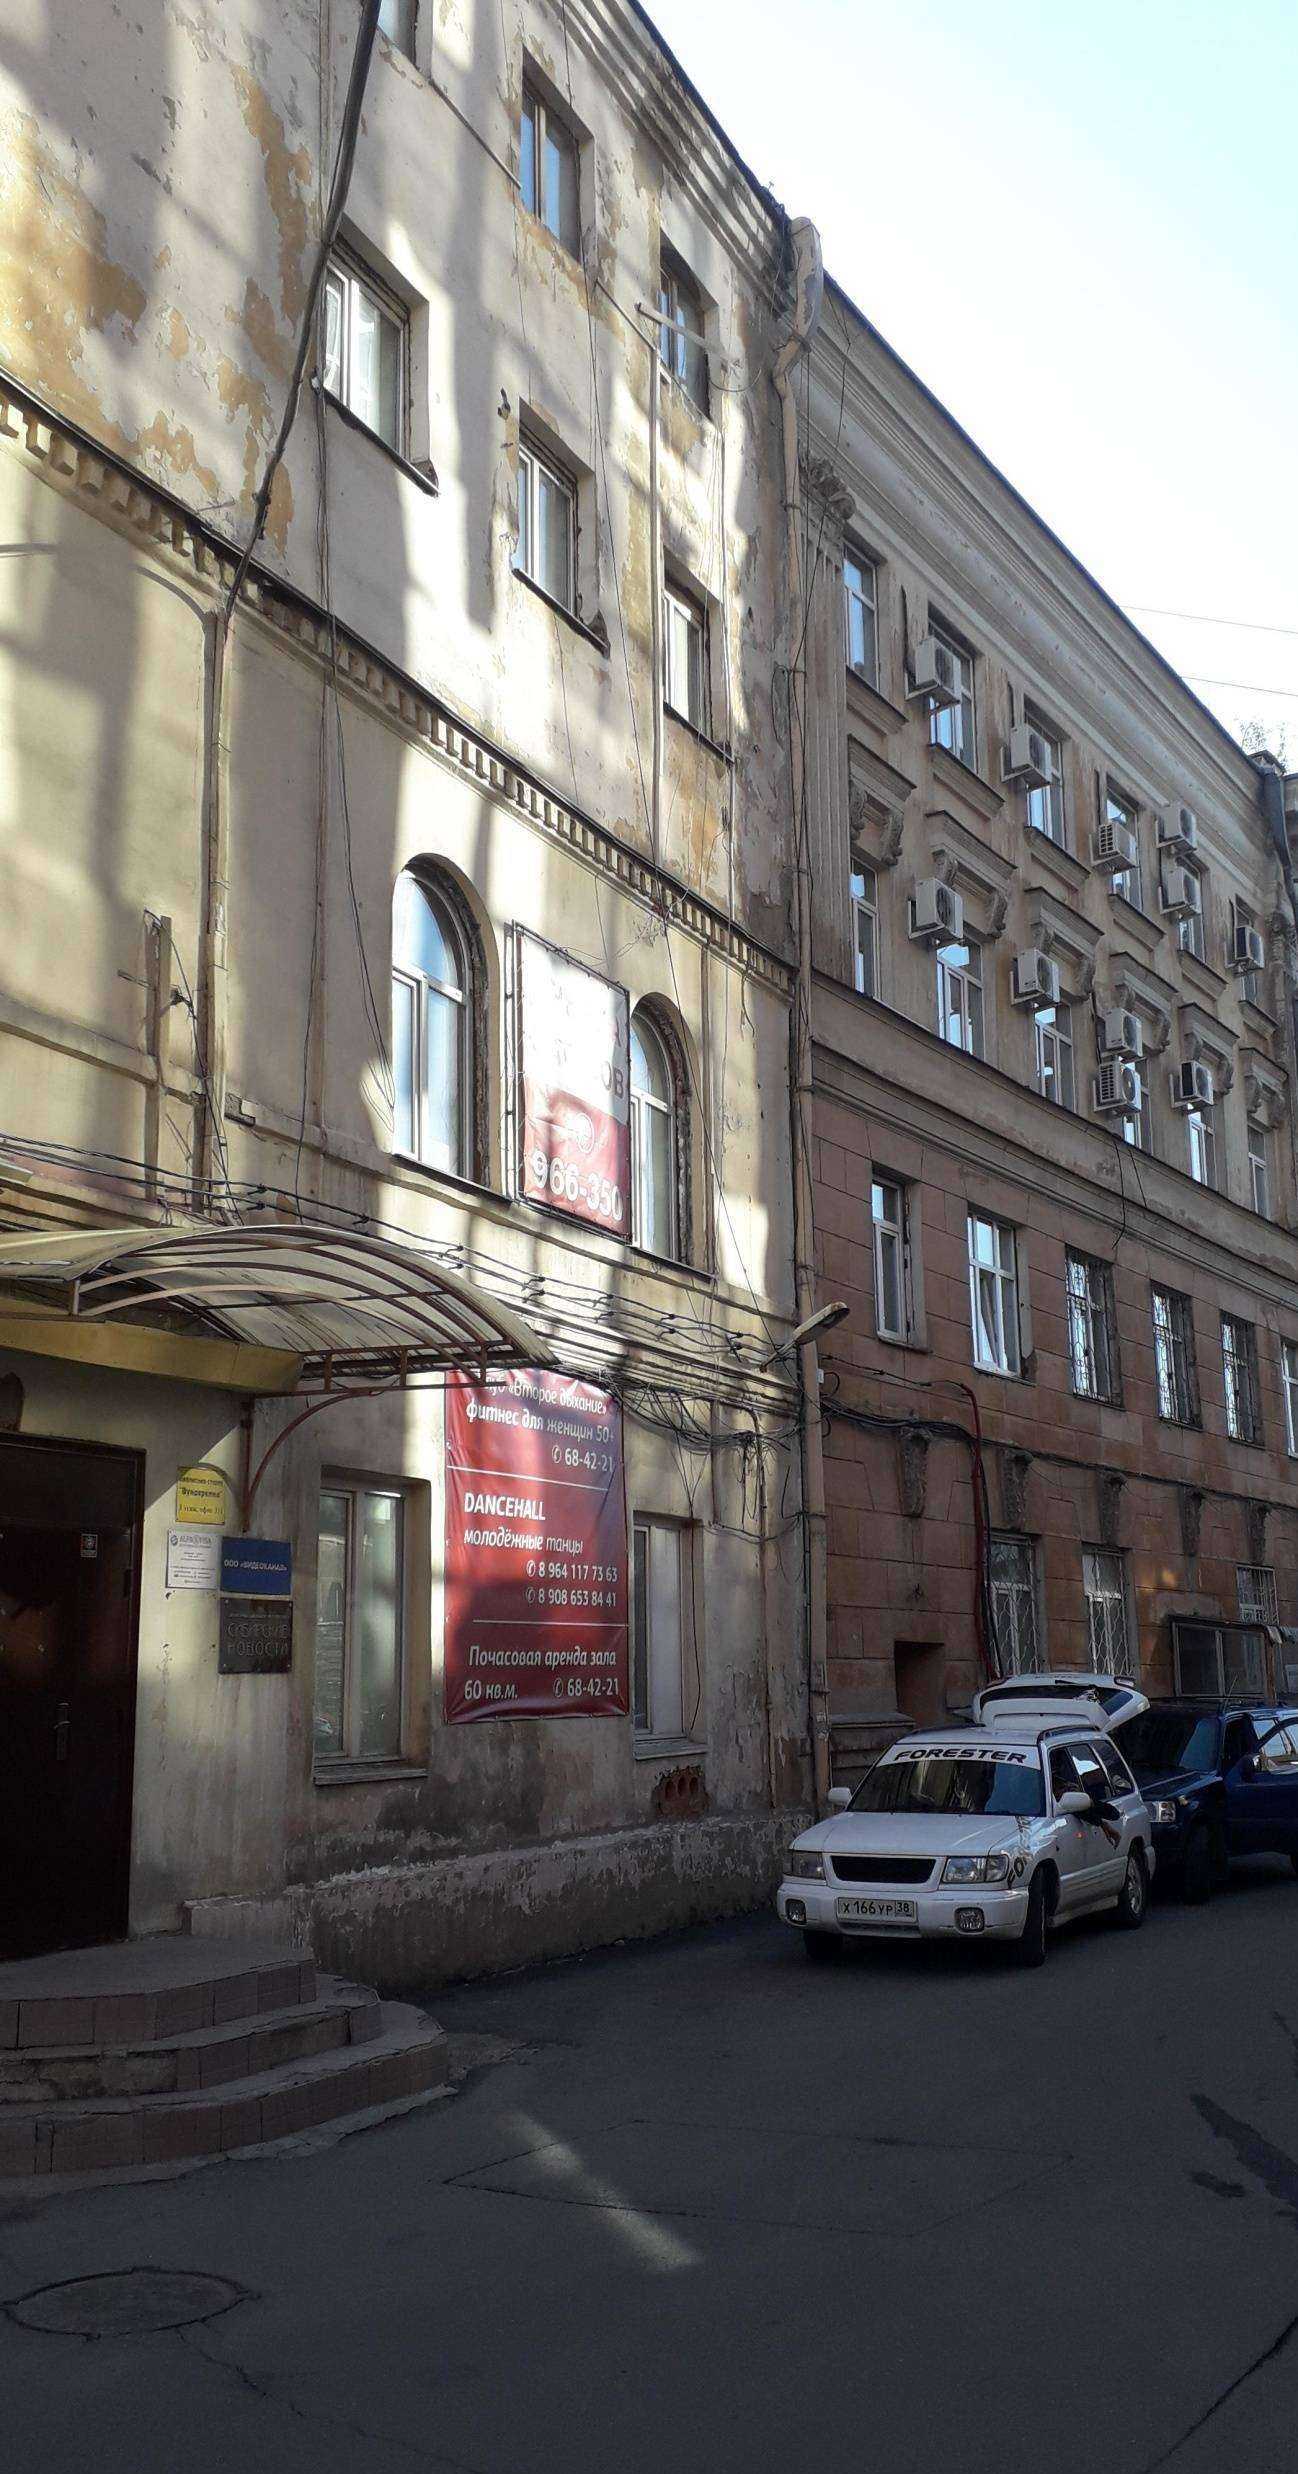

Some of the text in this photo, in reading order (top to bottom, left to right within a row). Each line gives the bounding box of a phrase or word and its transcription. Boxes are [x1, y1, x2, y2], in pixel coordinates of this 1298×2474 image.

[531, 1151, 623, 1221] 966-350
[466, 1398, 614, 1443] фитнес для женщин 50+
[564, 1448, 613, 1473] 68-42-21
[464, 1492, 546, 1521] DANCEHALL
[464, 1527, 583, 1556] молодёжные танцы
[223, 1559, 239, 1568] ООО
[538, 1562, 618, 1583] 8 964 117 73 63
[538, 1589, 616, 1607] 8 908 653 84 41
[469, 1645, 617, 1670] Почасовая аренда зала
[464, 1680, 482, 1700] 60
[567, 1677, 619, 1698] 68-42-21
[894, 1748, 1027, 1764] FORESTER
